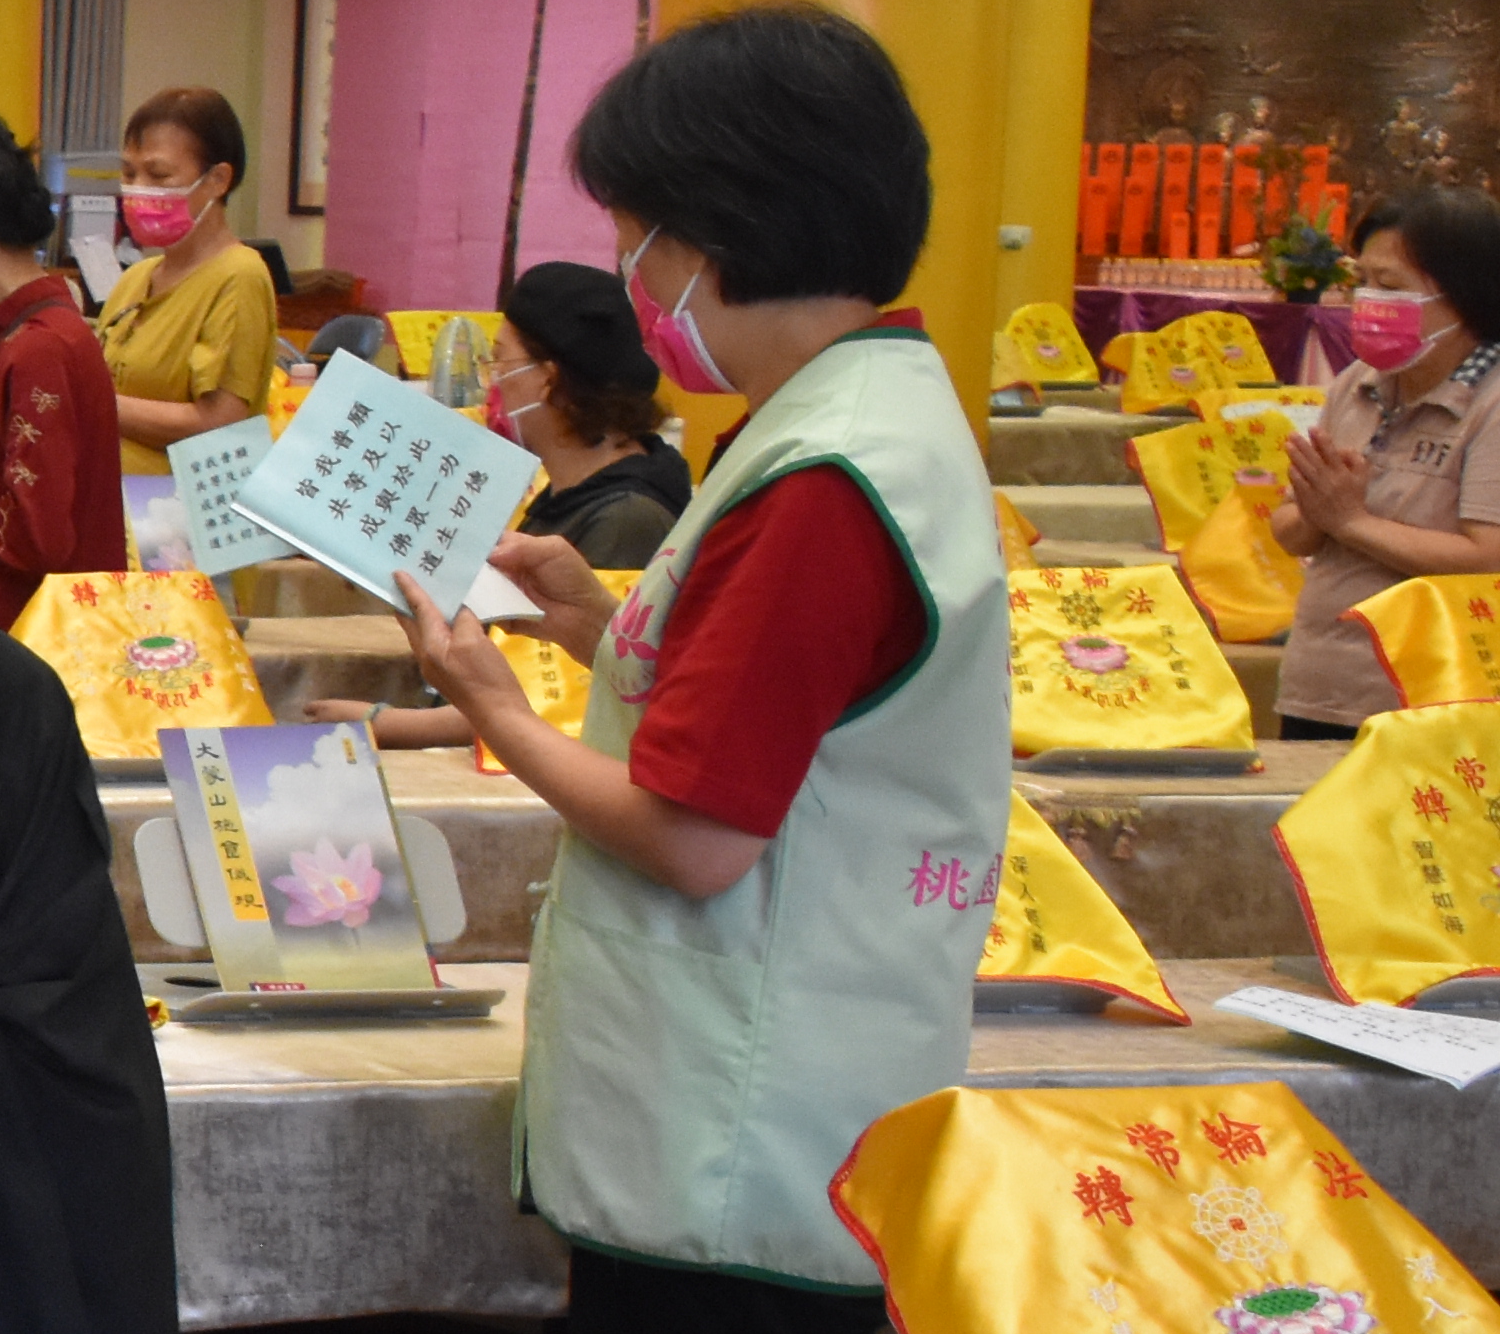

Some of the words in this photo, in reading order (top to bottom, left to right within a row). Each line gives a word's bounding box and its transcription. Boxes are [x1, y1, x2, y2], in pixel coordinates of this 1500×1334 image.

[331, 430, 471, 519] 普及於一切
[347, 401, 489, 494] 願以此功德
[295, 478, 443, 576] 皆共成佛道
